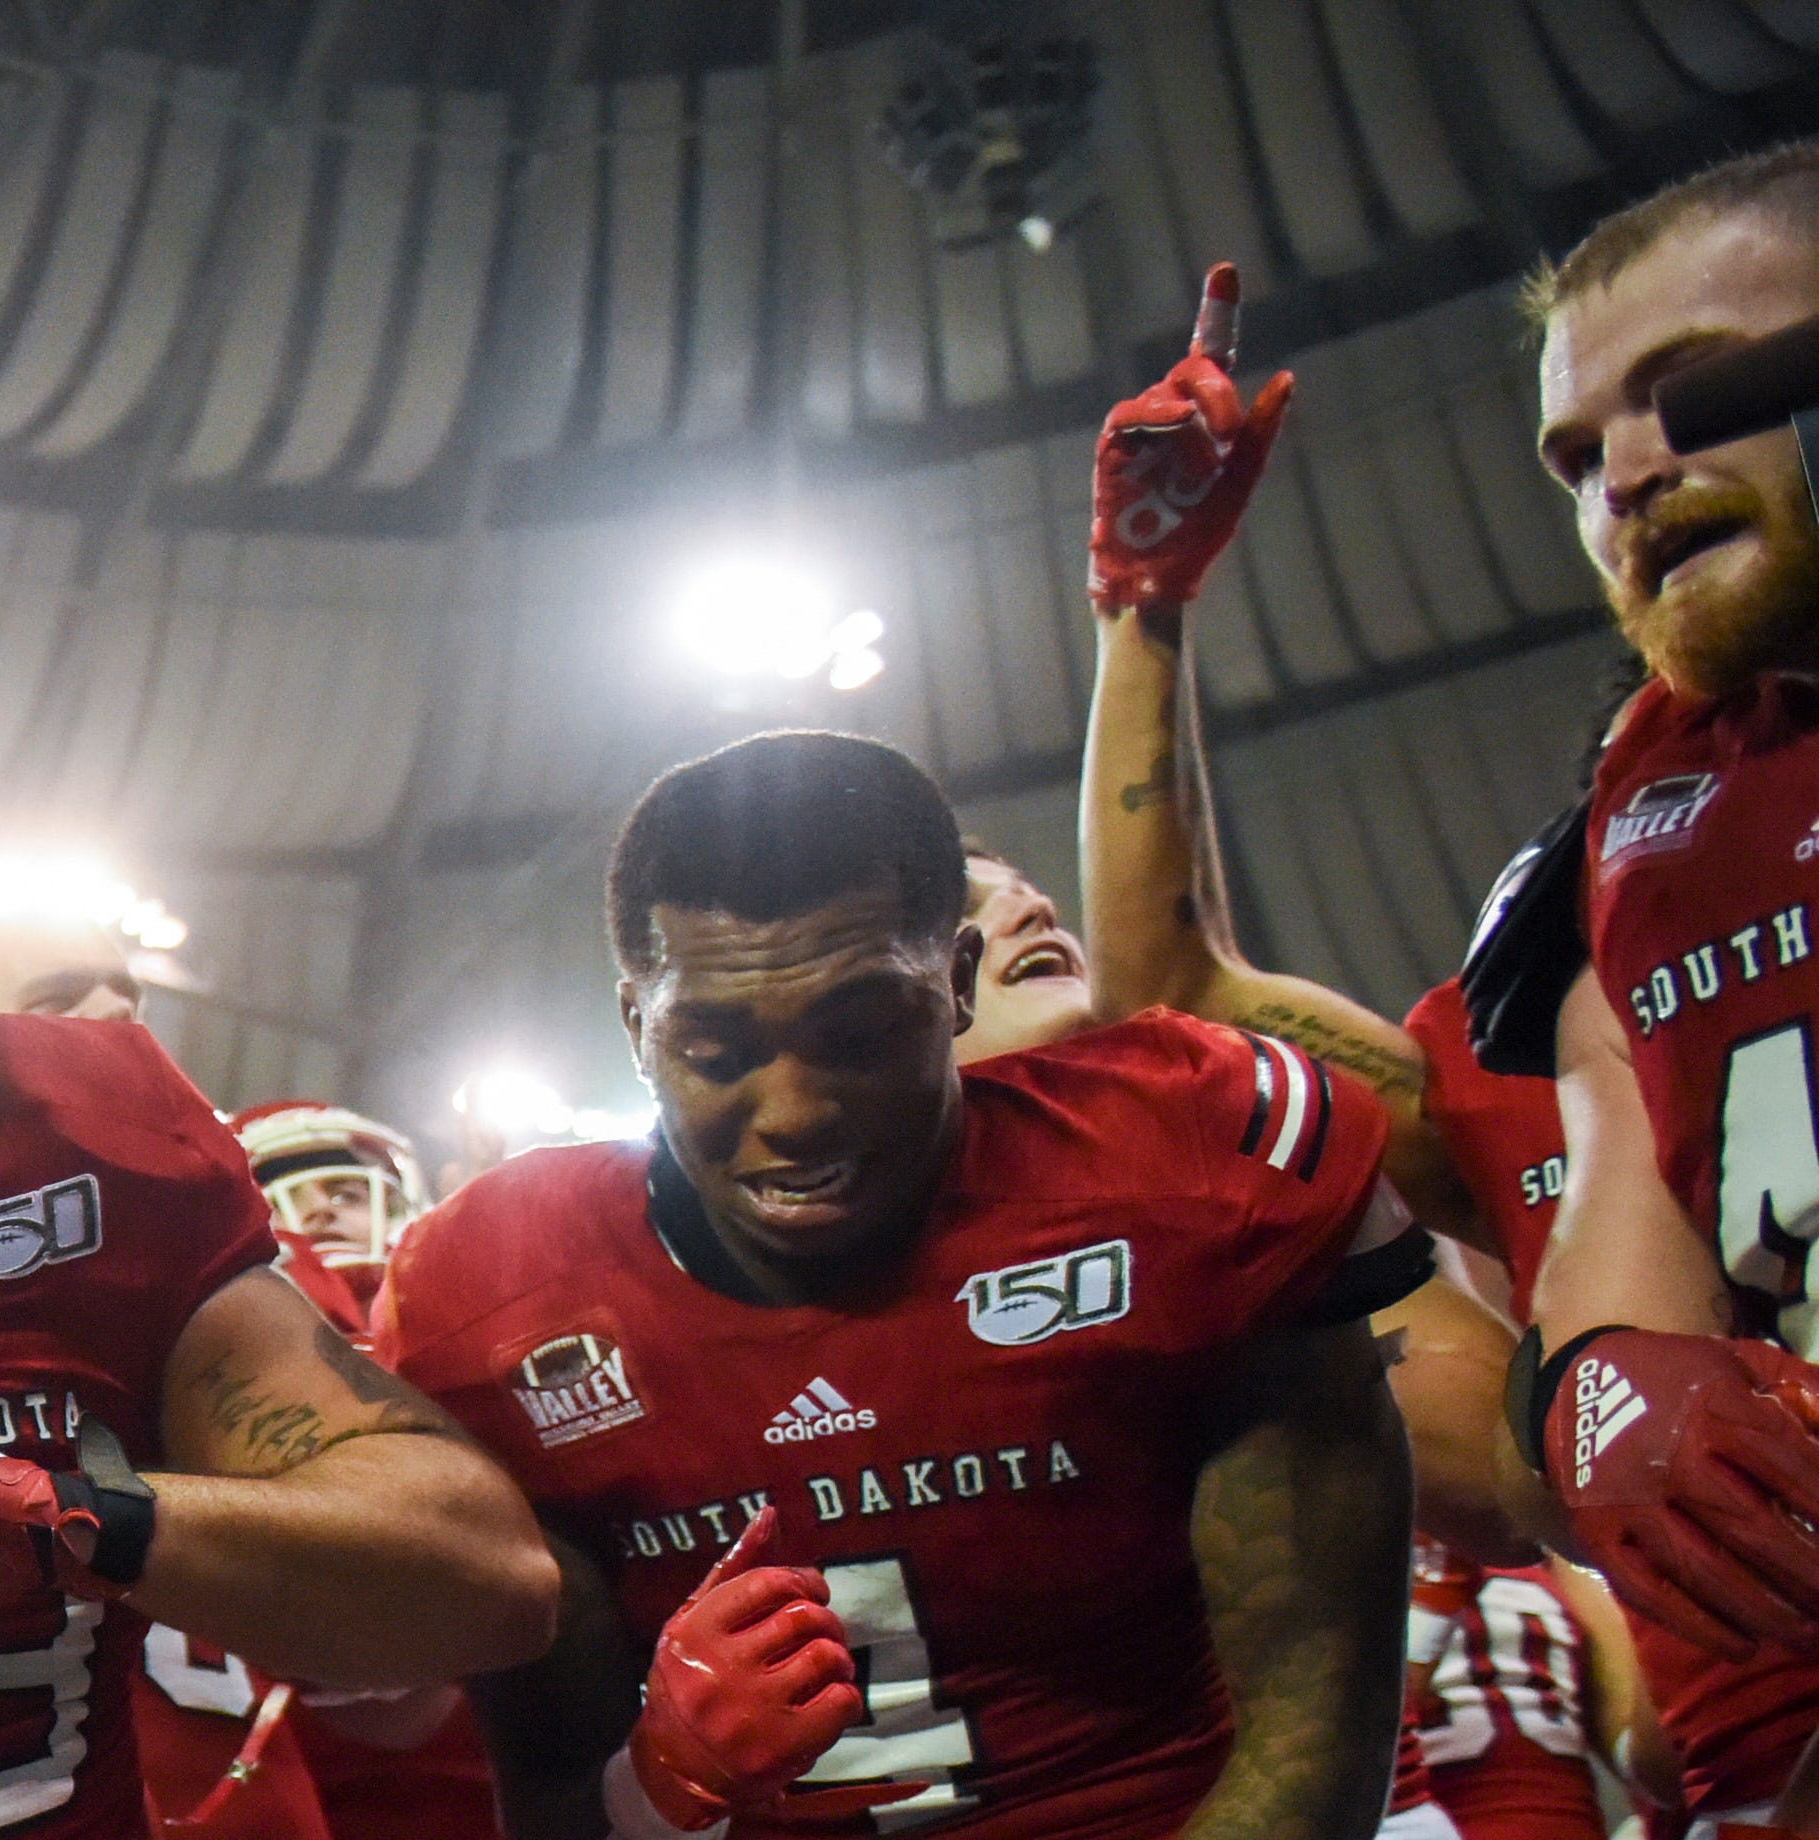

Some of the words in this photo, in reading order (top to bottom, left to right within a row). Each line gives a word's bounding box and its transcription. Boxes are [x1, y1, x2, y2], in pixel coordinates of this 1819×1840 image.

[1631, 905, 1810, 1034] SOUTH
[953, 1238, 1131, 1346] 150
[513, 1346, 632, 1428] VALLEY
[764, 1408, 878, 1445] adidas
[1575, 1358, 1603, 1489] adidas
[621, 1492, 771, 1558] OUTH
[809, 1439, 1080, 1521] DAKOTA
